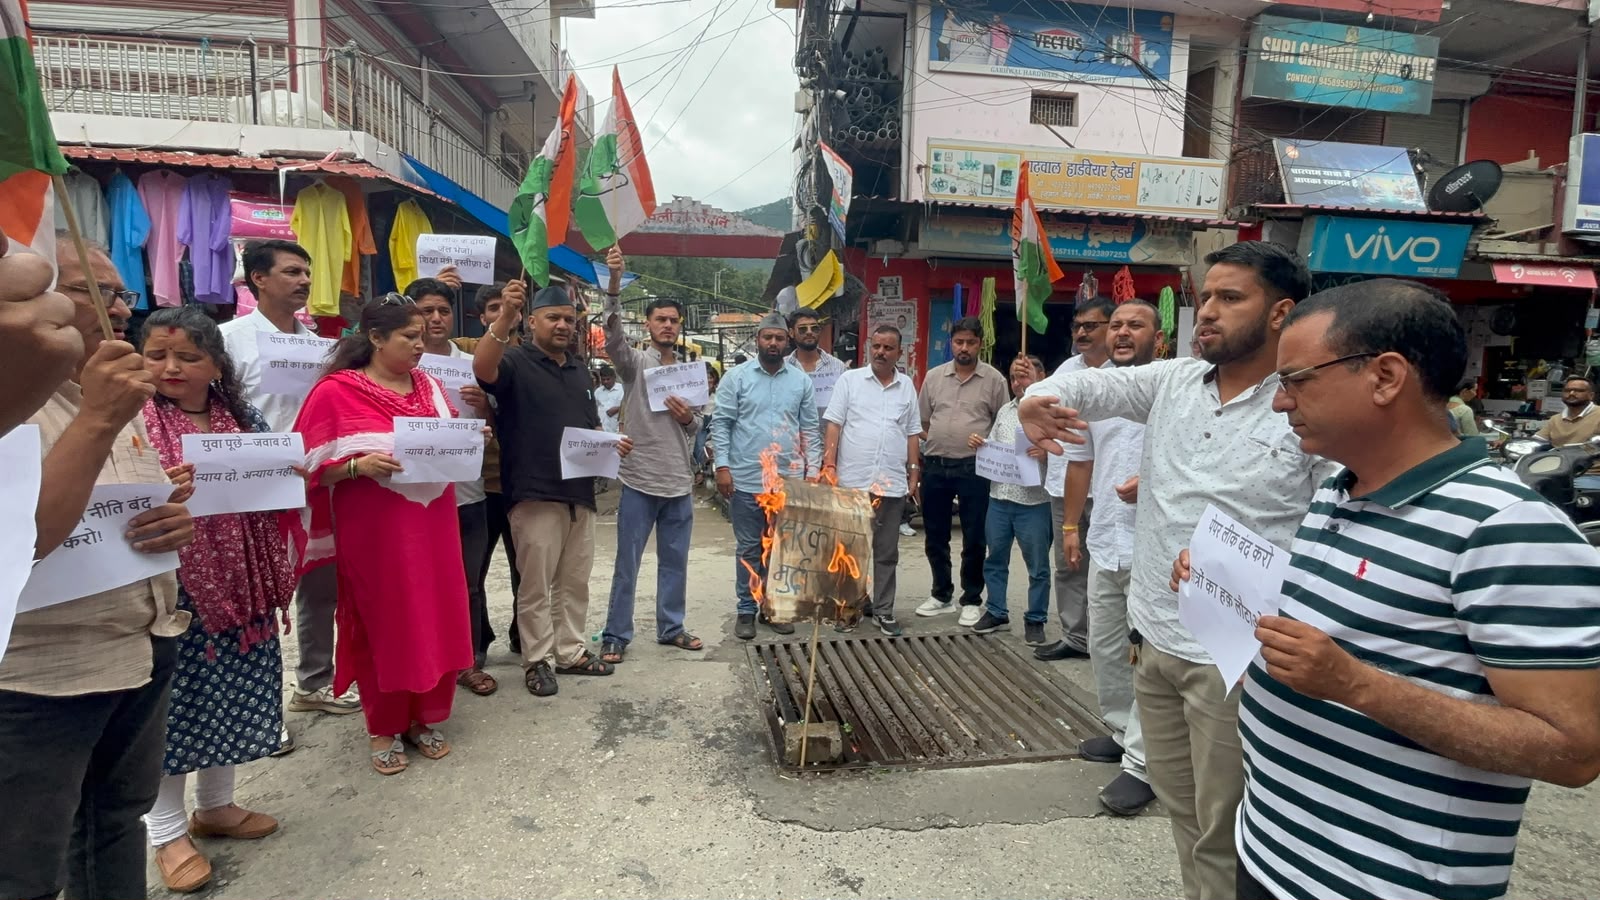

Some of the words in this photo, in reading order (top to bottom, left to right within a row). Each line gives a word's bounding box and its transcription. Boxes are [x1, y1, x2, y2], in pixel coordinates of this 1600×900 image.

[1034, 33, 1082, 51] VECTUS
[1260, 36, 1296, 64] SHRI
[1298, 42, 1359, 72] GANPATI
[1344, 225, 1441, 263] vivo
[419, 254, 439, 264] शिक्षा
[439, 256, 453, 264] मंत्री
[483, 260, 491, 269] दो
[269, 334, 287, 345] पेपर
[288, 336, 306, 345] लीक
[290, 361, 301, 369] का
[443, 367, 460, 377] नीति
[408, 421, 424, 432] युवा
[470, 420, 478, 431] दो
[201, 438, 223, 452] युवा
[280, 434, 292, 447] दो
[404, 447, 424, 456] न्याय
[438, 447, 463, 456] अन्याय
[196, 470, 223, 482] न्याय
[225, 468, 239, 482] दो,
[242, 468, 274, 480] अन्याय
[87, 499, 125, 519] नीति
[127, 495, 152, 511] बंद
[63, 527, 103, 550] करो!
[1208, 513, 1224, 539] पेपर
[1221, 523, 1241, 547] लीक
[1238, 534, 1254, 559] बंद
[1252, 544, 1275, 570] करो
[1205, 577, 1219, 598] का
